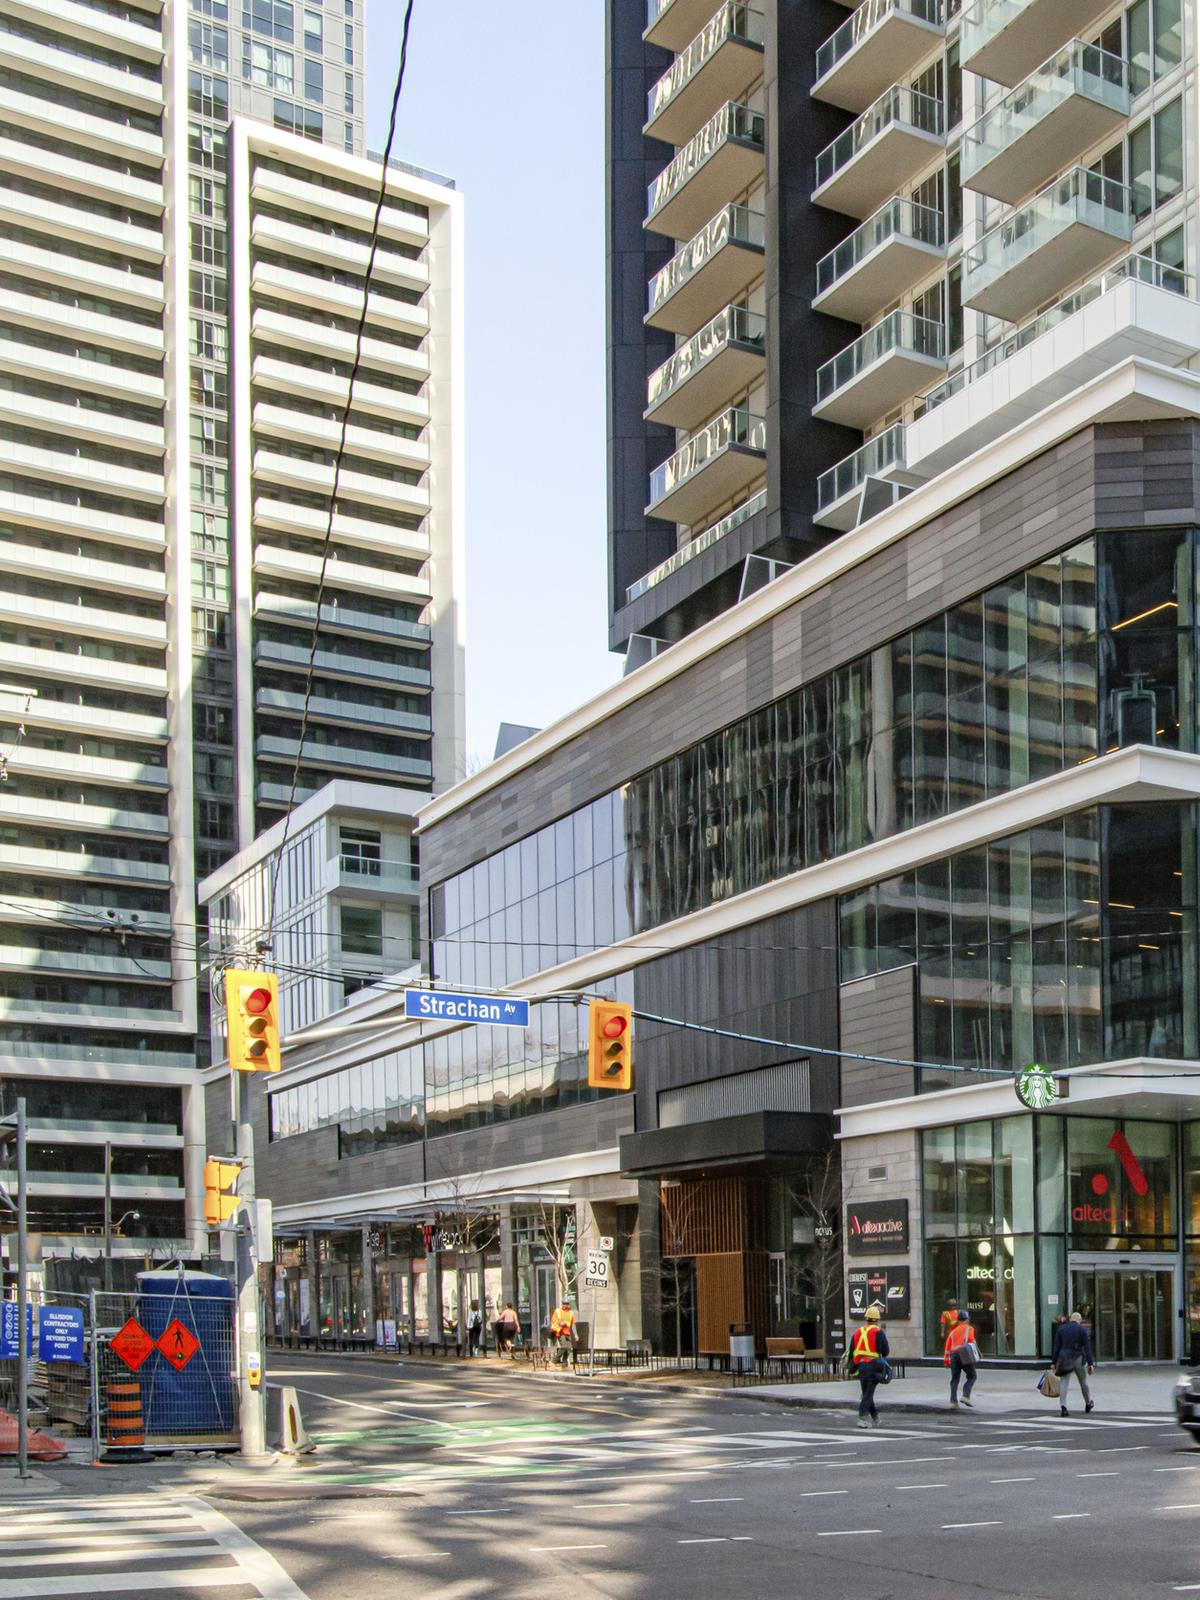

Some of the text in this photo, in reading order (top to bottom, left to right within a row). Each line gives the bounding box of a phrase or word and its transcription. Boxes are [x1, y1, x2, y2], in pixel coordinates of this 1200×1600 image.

[420, 995, 516, 1020] Strachan Av
[589, 1261, 607, 1276] 30
[43, 1320, 79, 1328] CONTRACTORS
